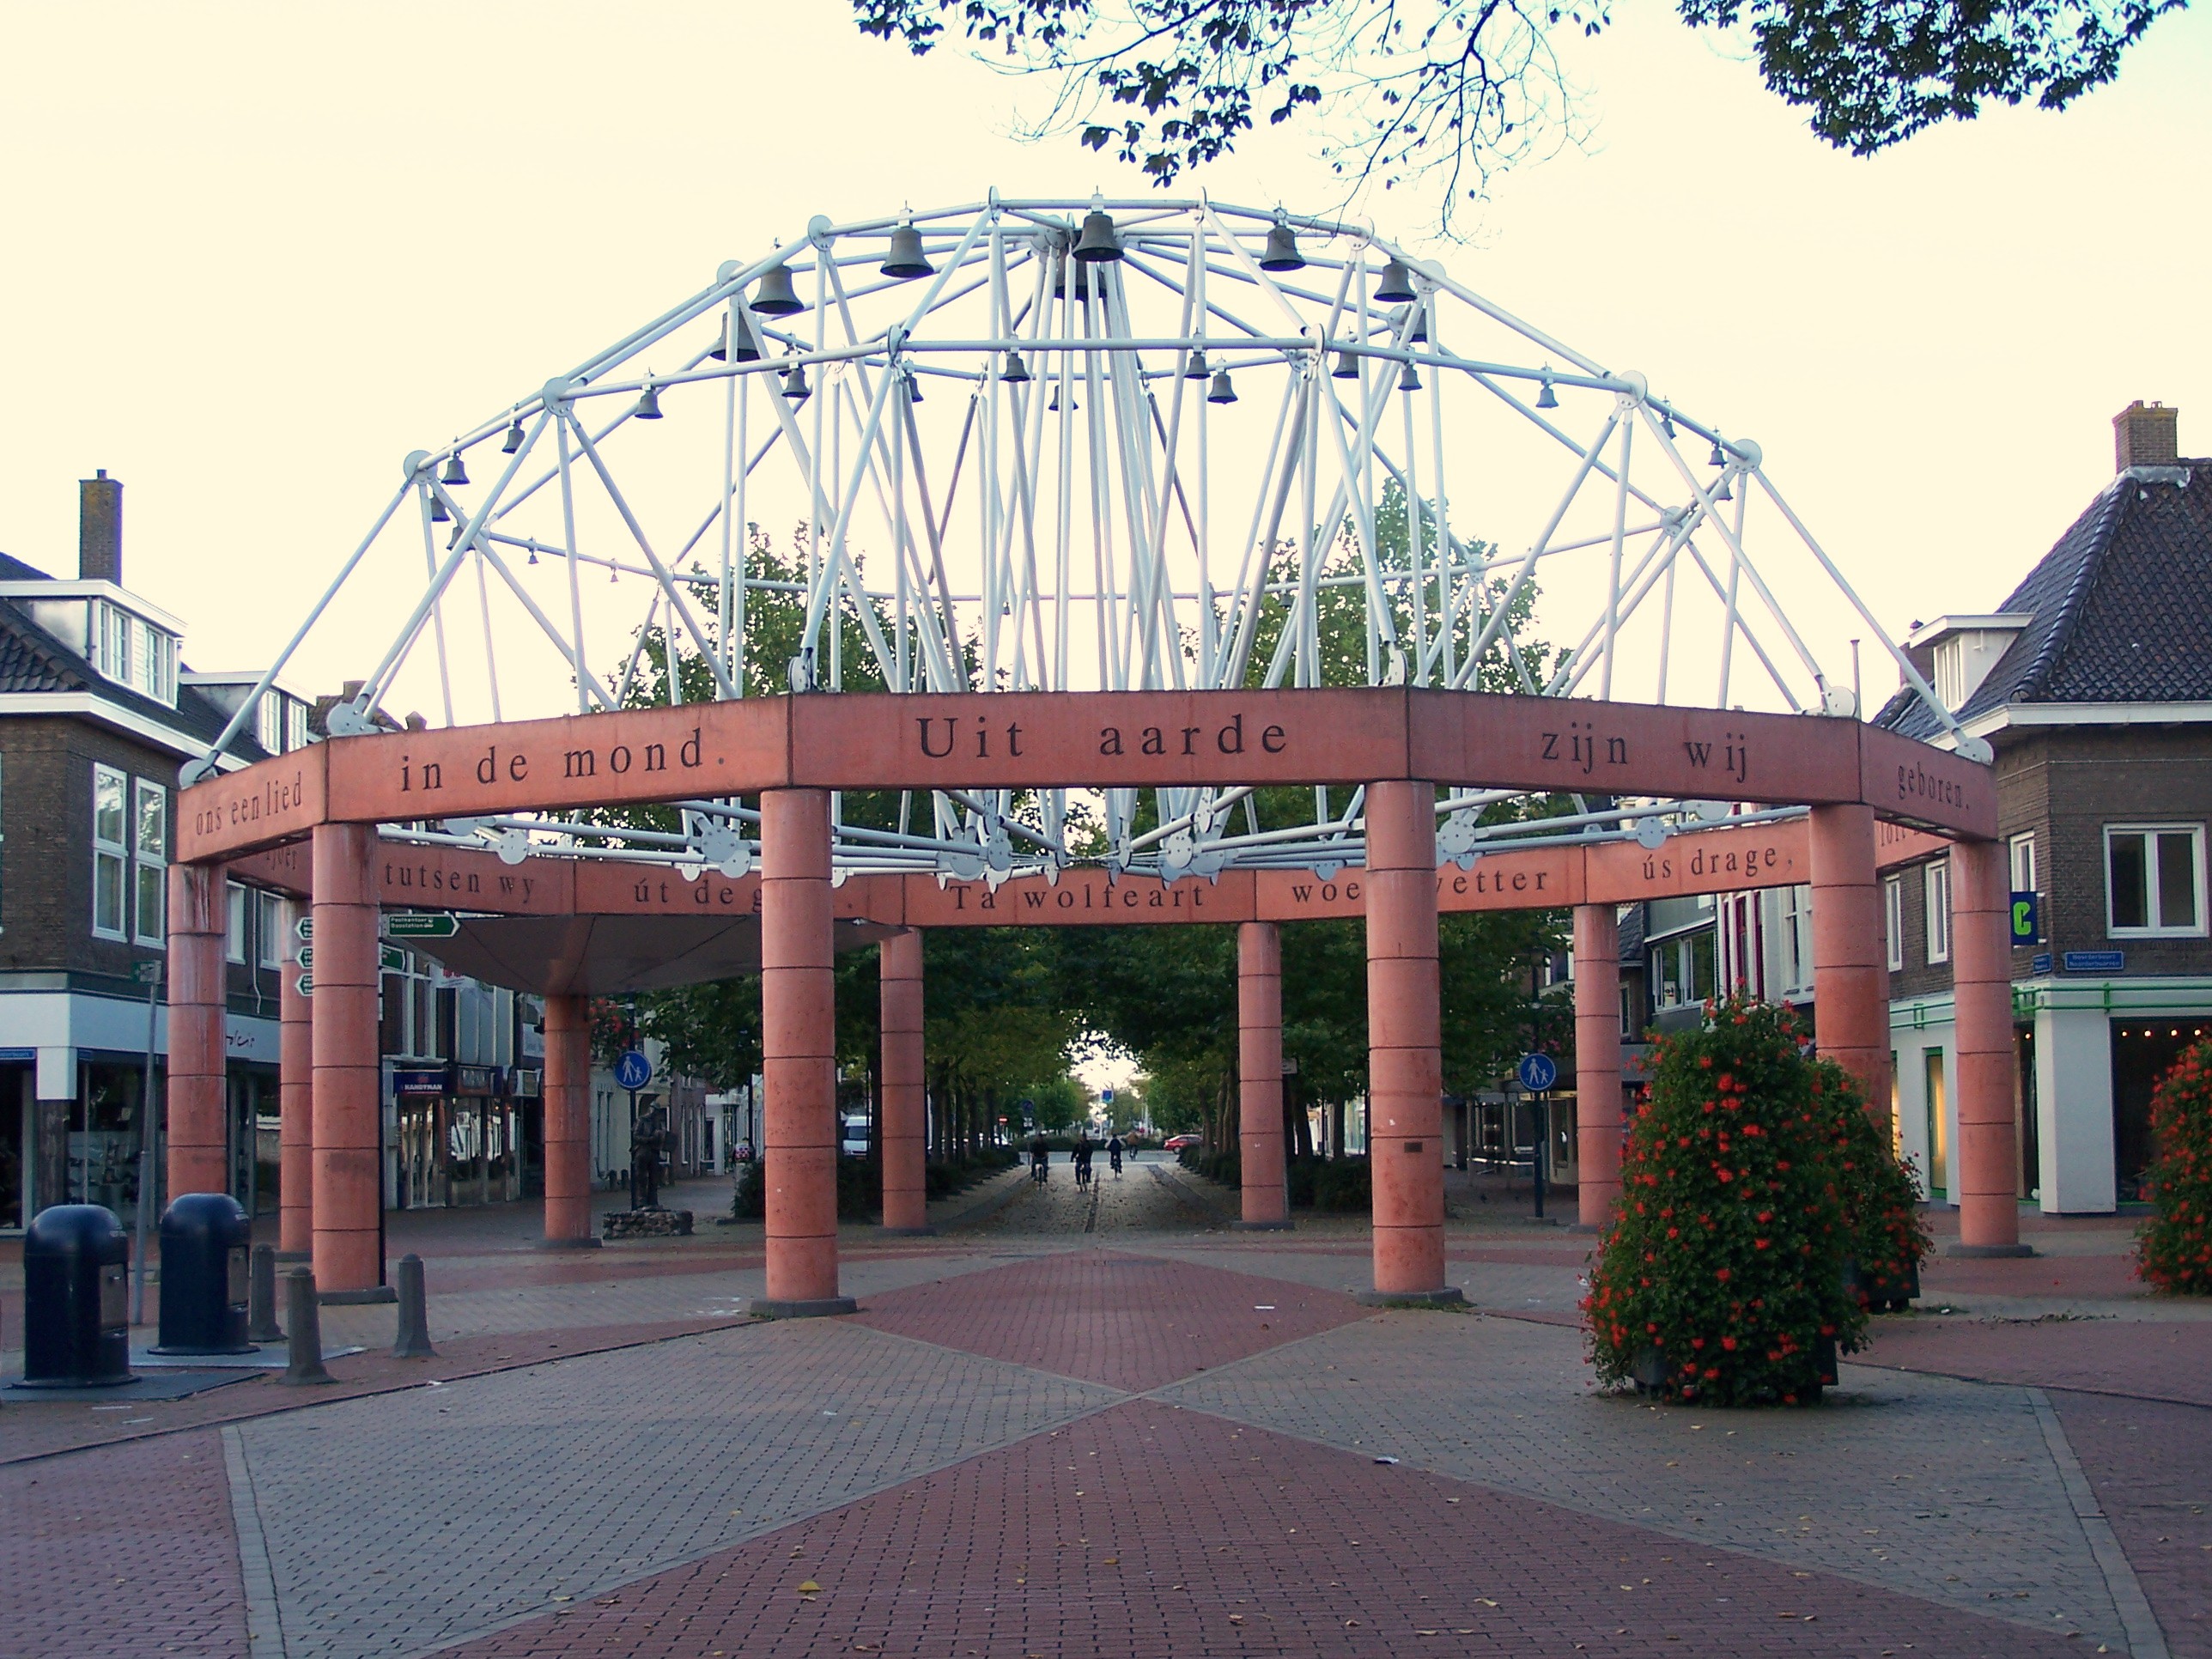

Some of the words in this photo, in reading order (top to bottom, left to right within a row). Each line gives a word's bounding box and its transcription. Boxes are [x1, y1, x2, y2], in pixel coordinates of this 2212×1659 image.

[915, 716, 1024, 758] Uit
[1099, 714, 1289, 756] aarde
[1541, 722, 1628, 775] zijn
[1684, 732, 1748, 784] wij
[400, 756, 443, 793] in
[477, 746, 529, 786] de
[564, 727, 726, 779] mond.
[196, 806, 222, 836] ons
[232, 795, 259, 825] een
[265, 771, 301, 817] lied
[1898, 761, 1969, 810] geboren.
[385, 860, 481, 894] tutsen
[498, 875, 536, 903] wy
[1436, 871, 1547, 895] etter
[1642, 854, 1671, 881] ús
[1692, 846, 1793, 877] drage,
[634, 878, 669, 902] út
[694, 879, 733, 904] de
[950, 885, 996, 910] Ta
[1024, 883, 1206, 909] wolfeart
